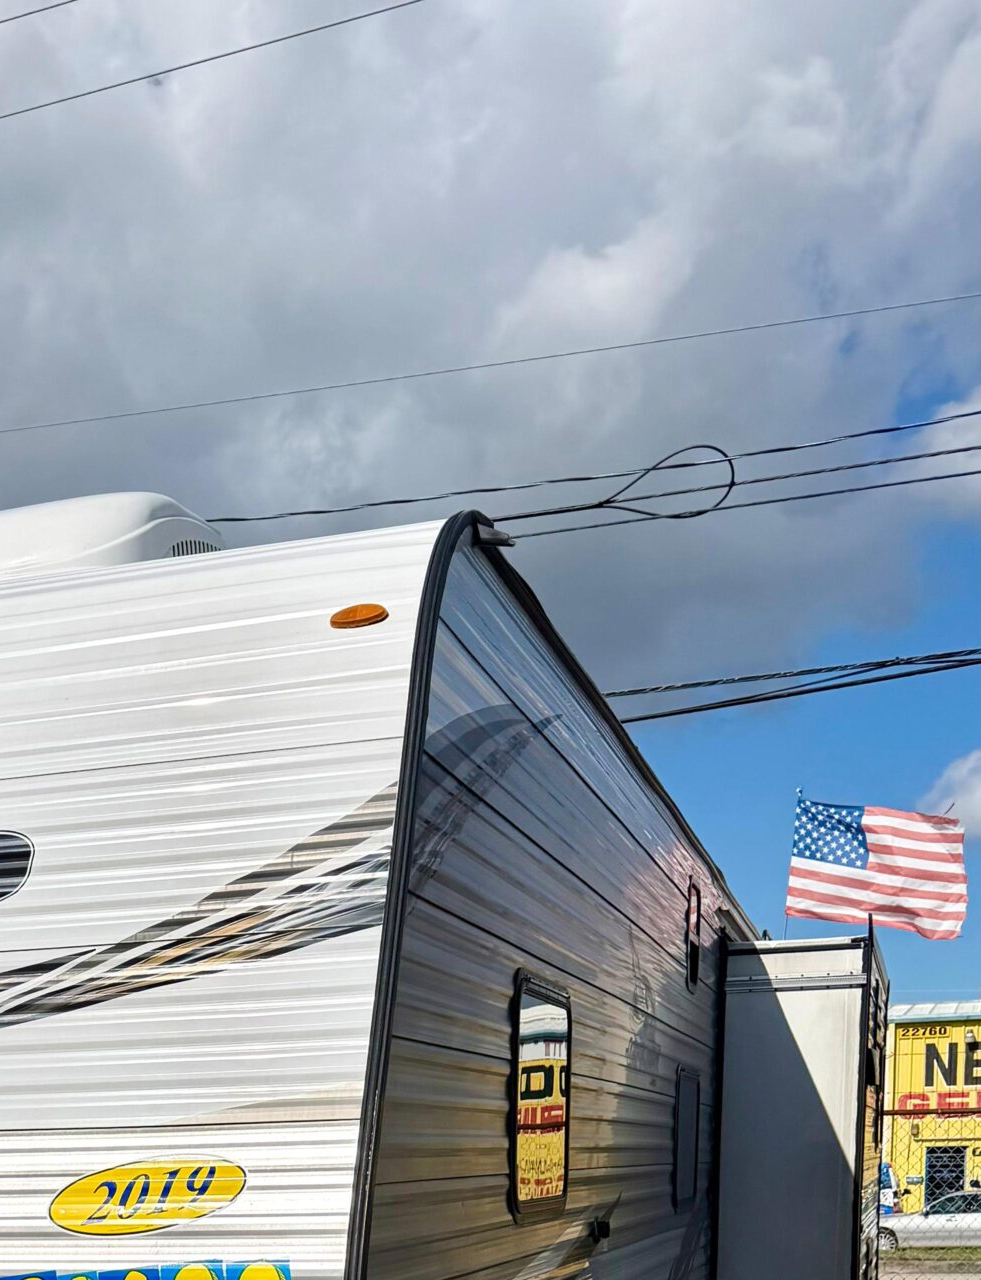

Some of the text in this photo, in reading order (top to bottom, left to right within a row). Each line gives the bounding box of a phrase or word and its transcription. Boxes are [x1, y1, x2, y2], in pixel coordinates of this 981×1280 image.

[901, 1027, 947, 1037] 22760
[897, 1092, 981, 1119] GE
[81, 1166, 216, 1226] 2019
